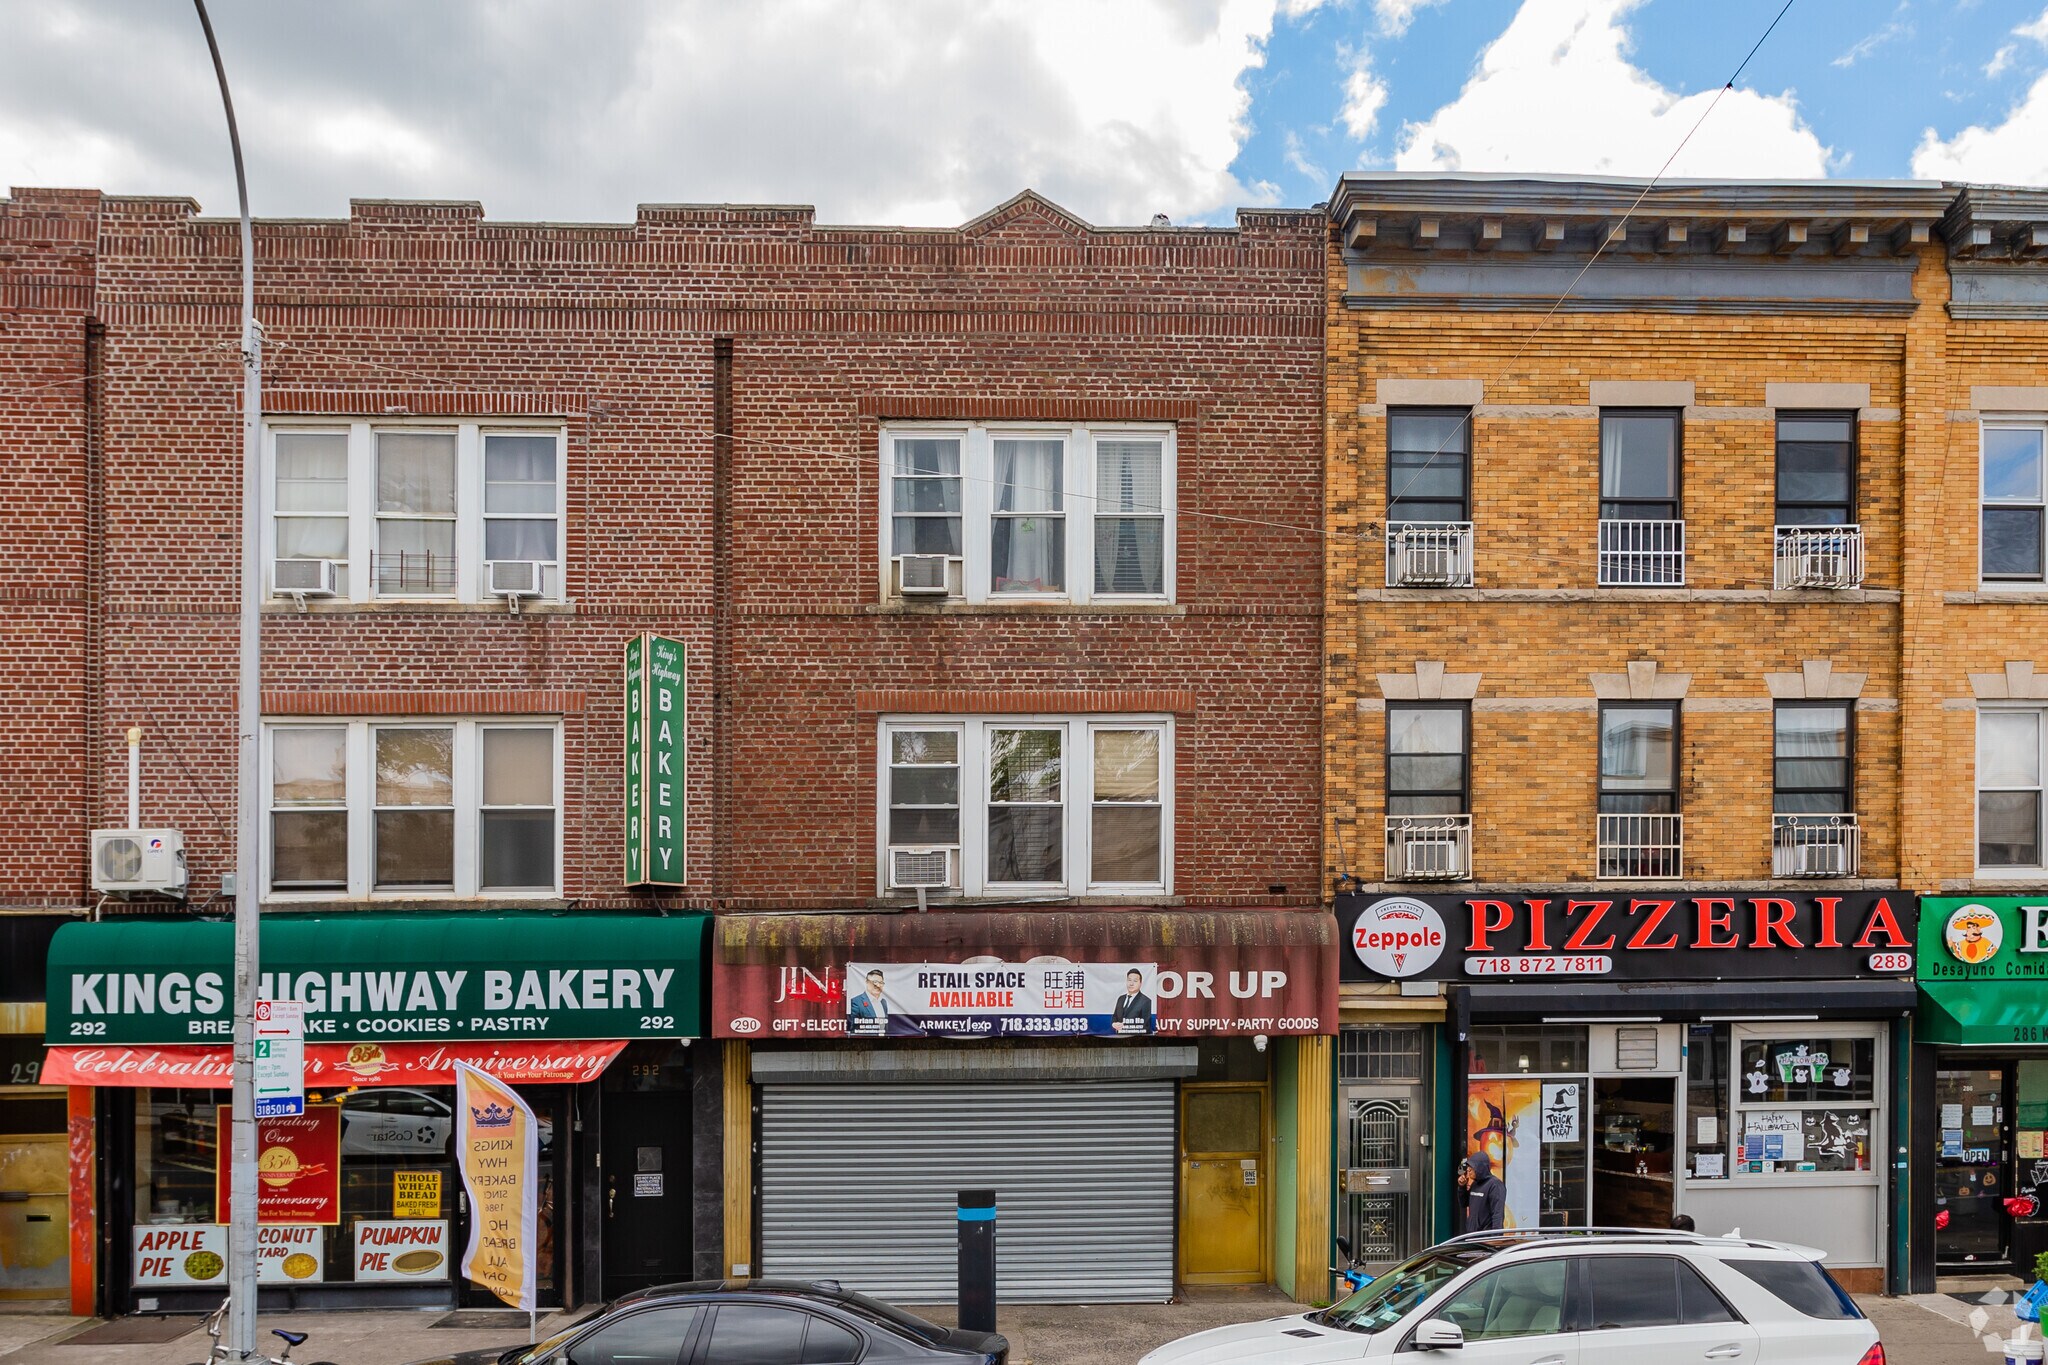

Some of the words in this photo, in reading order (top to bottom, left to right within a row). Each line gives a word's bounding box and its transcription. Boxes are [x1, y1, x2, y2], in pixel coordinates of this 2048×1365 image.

[657, 645, 677, 665] King's
[652, 662, 681, 687] Highway
[631, 689, 640, 871] BAKERY
[658, 687, 672, 871] BAKERY
[1465, 897, 1913, 951] PIZZERIA
[1355, 926, 1442, 951] Zeppole
[1476, 959, 1511, 974] 718
[1519, 958, 1556, 973] 872
[1562, 957, 1604, 972] 7811
[1873, 954, 1908, 970] 288
[1933, 961, 1996, 980] Desayuno
[918, 972, 971, 988] RETAIL
[975, 972, 1026, 988] SPACE
[1044, 970, 1085, 989] 旺鋪
[1229, 971, 1287, 998] UP
[71, 972, 224, 1015] KINGS
[484, 968, 675, 1010] BAKERY
[929, 991, 1014, 1007] AVAILABLE
[1044, 990, 1085, 1008] 出租
[70, 1022, 106, 1035] 292
[356, 1018, 451, 1033] COOKIES
[471, 1017, 550, 1031] PASTRY
[640, 1016, 674, 1029] 292
[734, 1019, 758, 1031] 290
[772, 1019, 799, 1031] GIFT
[1187, 1018, 1231, 1031] SUPPLY
[1237, 1018, 1274, 1030] PARTY
[1277, 1017, 1319, 1029] GOODS
[919, 1020, 967, 1030] ARMKEY
[1000, 1017, 1088, 1031] 718.333.9833
[2013, 1027, 2037, 1041] 286
[258, 1041, 267, 1056] 2
[72, 1049, 235, 1085] Celebratin
[503, 1071, 515, 1079] You
[516, 1071, 527, 1079] For
[528, 1070, 542, 1079] Your
[543, 1070, 574, 1079] Patronage
[632, 1065, 660, 1076] 292
[1546, 1113, 1573, 1125] TRICK
[1761, 1111, 1784, 1123] HAPPY
[1546, 1125, 1573, 1139] TREAT
[1747, 1121, 1800, 1132] HALLOWEEN
[264, 1128, 295, 1143] Our
[263, 1154, 292, 1169] 35th
[1964, 1149, 1988, 1162] OPEN
[397, 1174, 438, 1182] WHOLE
[1244, 1170, 1256, 1178] BNE
[398, 1182, 438, 1190] WHEAT
[399, 1191, 437, 1199] BREAD
[396, 1200, 418, 1208] BAKED
[418, 1200, 438, 1208] FRESH
[408, 1208, 426, 1216] DAILY
[138, 1231, 206, 1252] APPLE
[360, 1226, 442, 1245] PUMPKIN
[139, 1257, 175, 1277] PIE
[360, 1252, 391, 1271] PIE
